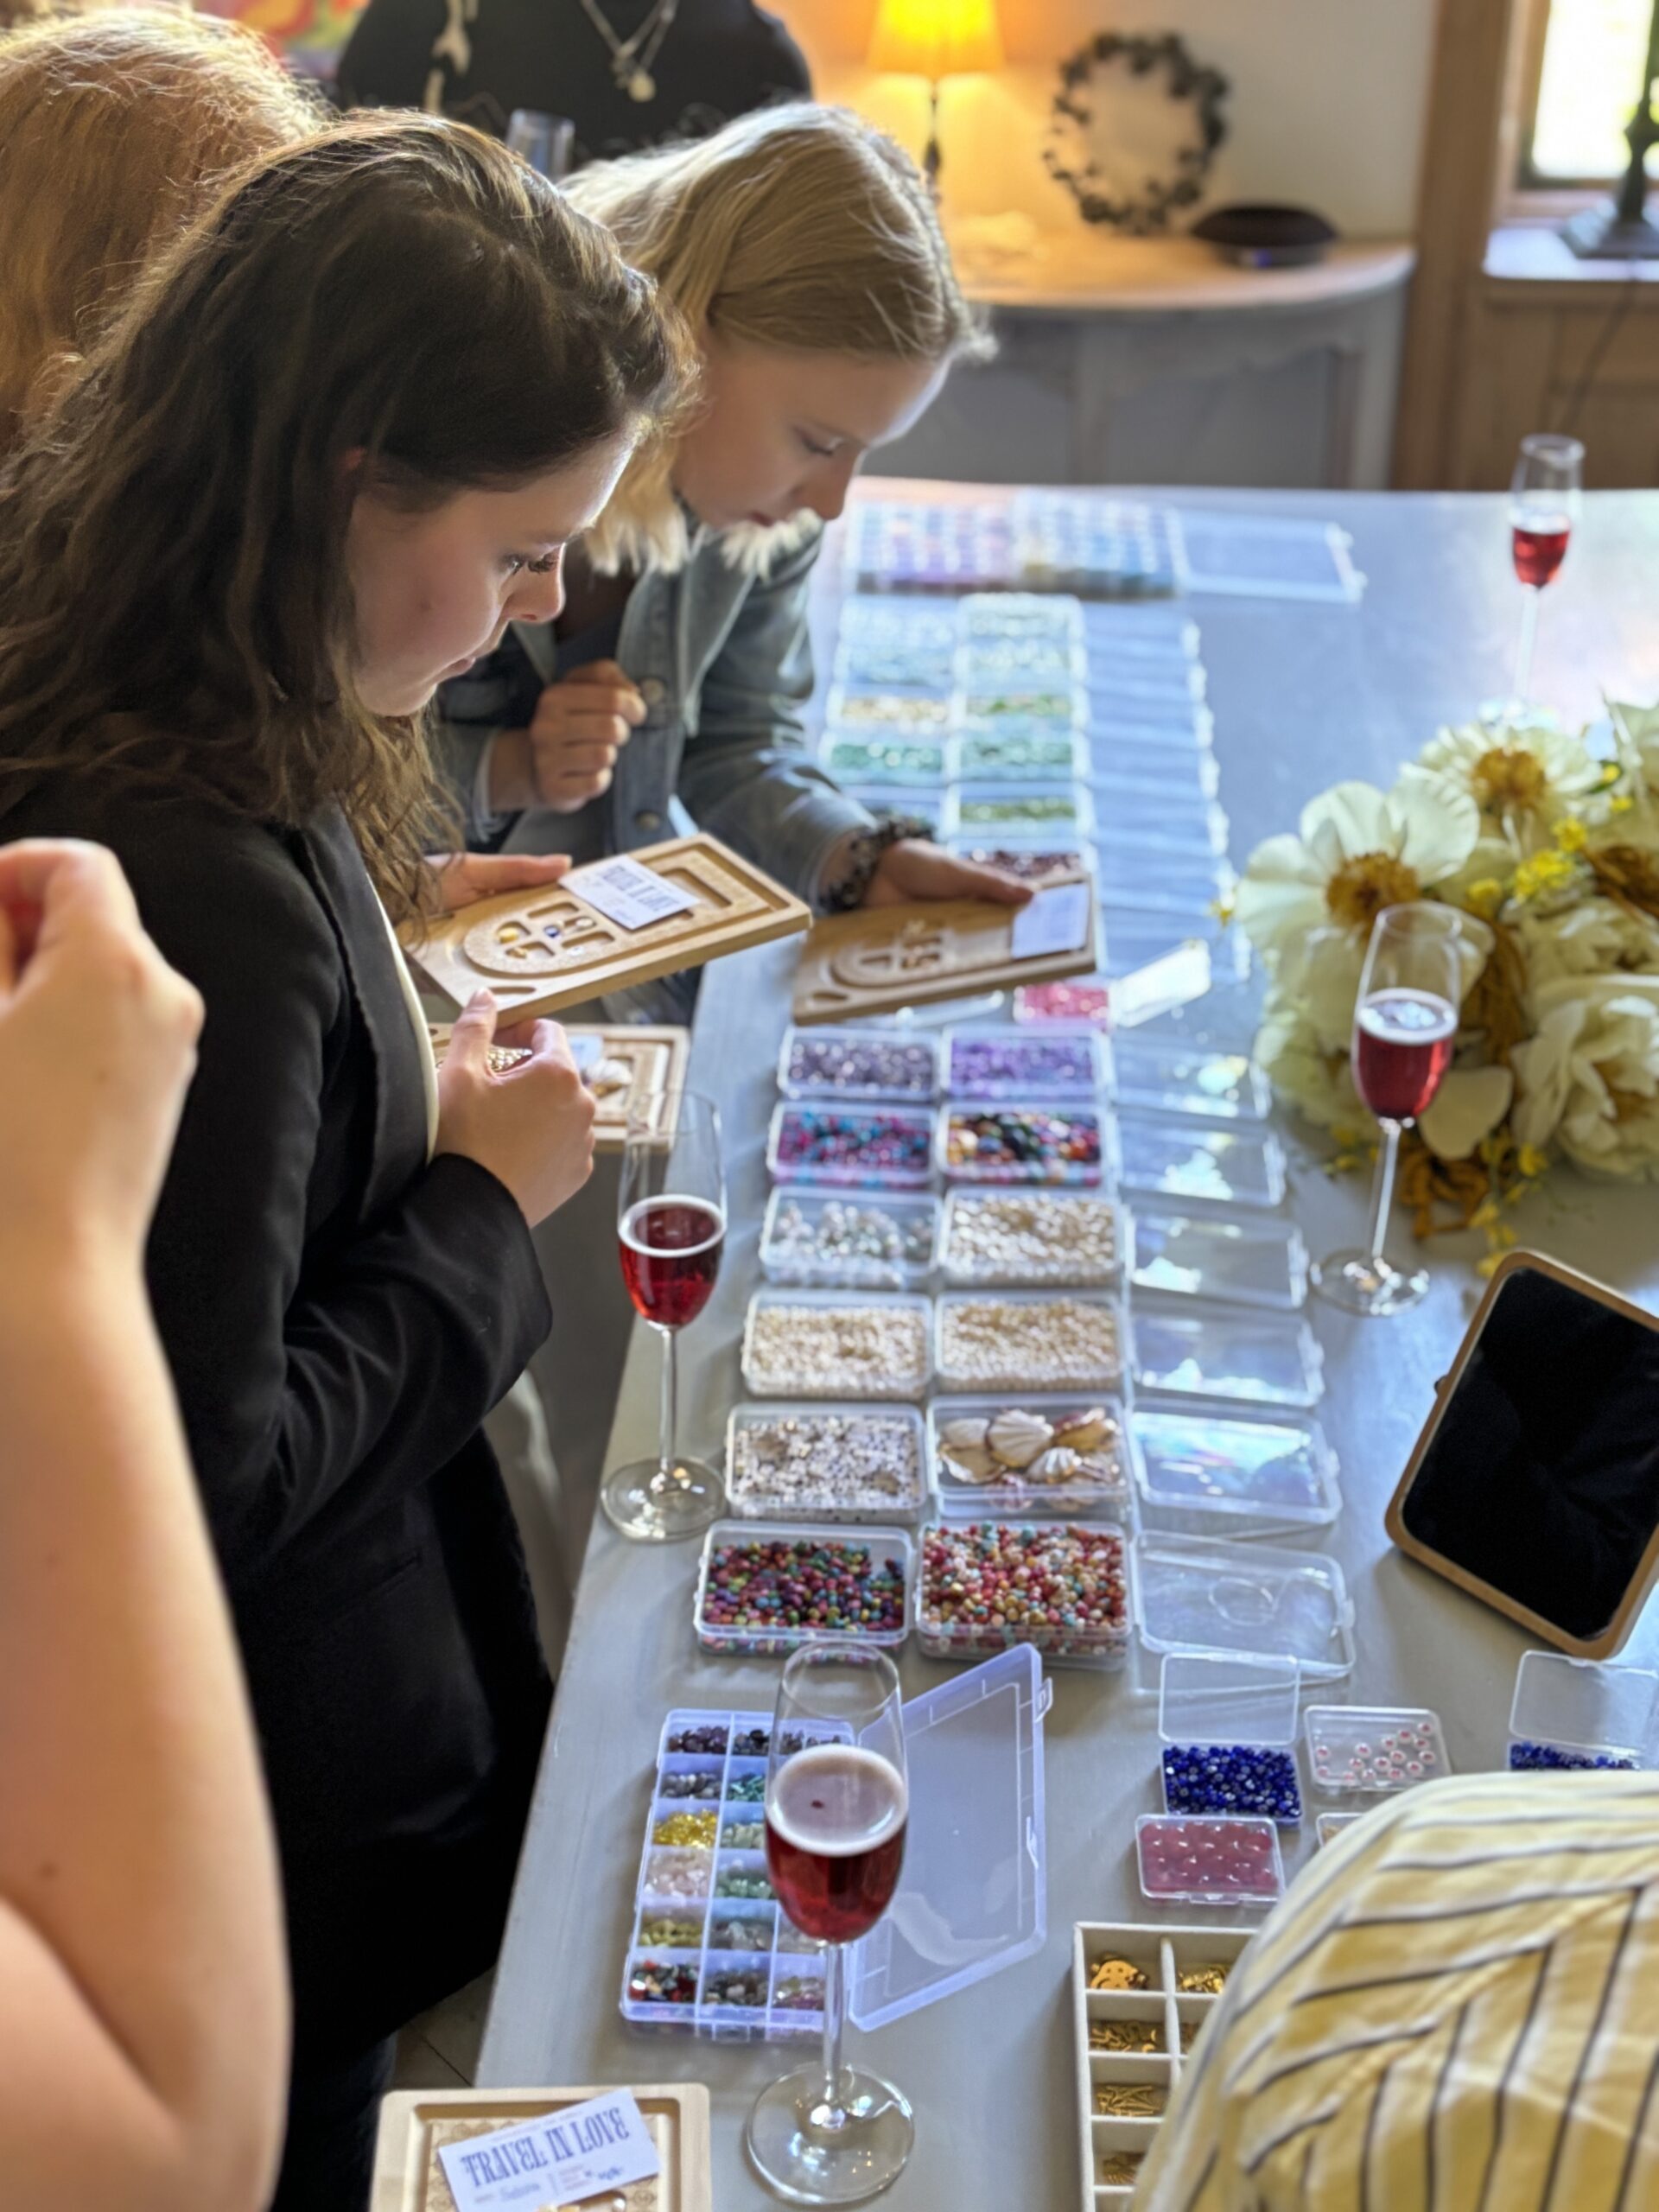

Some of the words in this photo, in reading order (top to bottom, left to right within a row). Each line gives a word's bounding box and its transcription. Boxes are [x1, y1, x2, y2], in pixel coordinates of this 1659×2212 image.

[461, 2135, 549, 2188] TRAVEL
[544, 2125, 574, 2161] IN
[570, 2107, 630, 2154] LOVE
